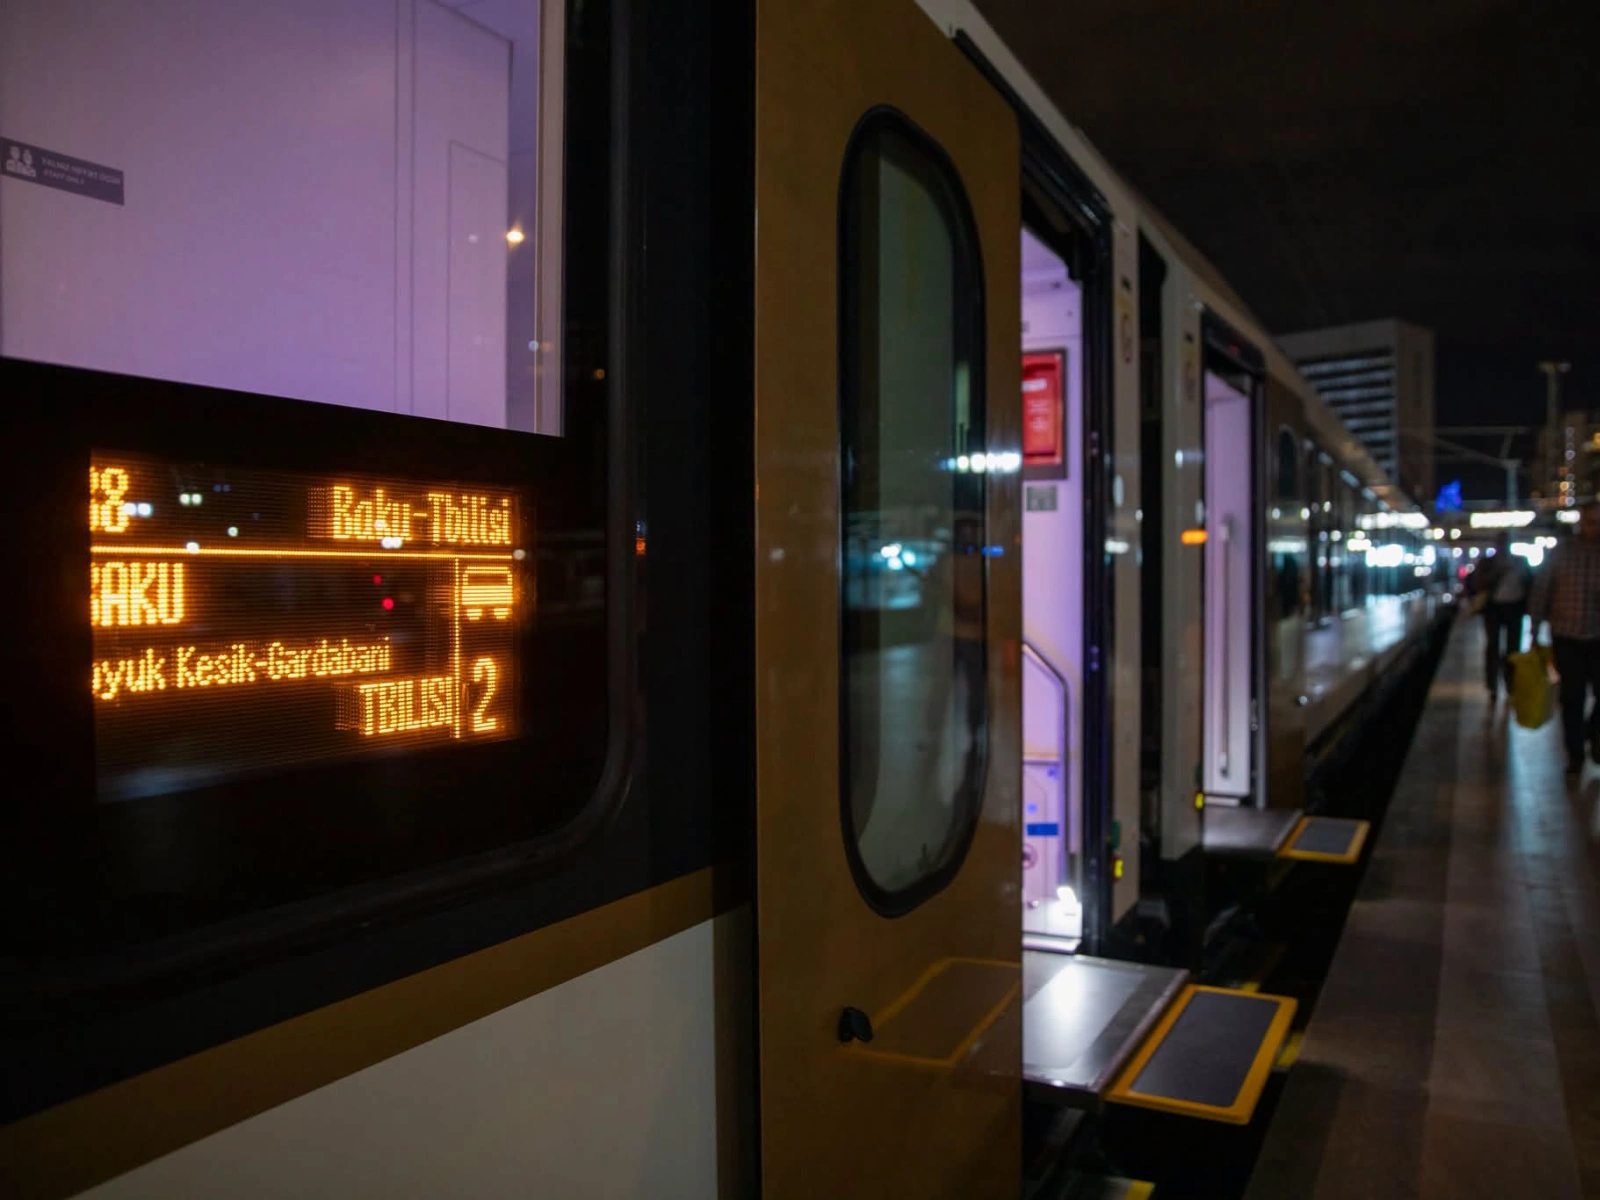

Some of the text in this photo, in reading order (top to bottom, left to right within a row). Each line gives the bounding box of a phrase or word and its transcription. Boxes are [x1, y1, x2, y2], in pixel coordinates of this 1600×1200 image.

[333, 485, 512, 545] Baku-Tbilisi
[177, 636, 389, 688] Kesik-Gardabani
[359, 676, 454, 736] TBILISI
[473, 657, 497, 732] 2
